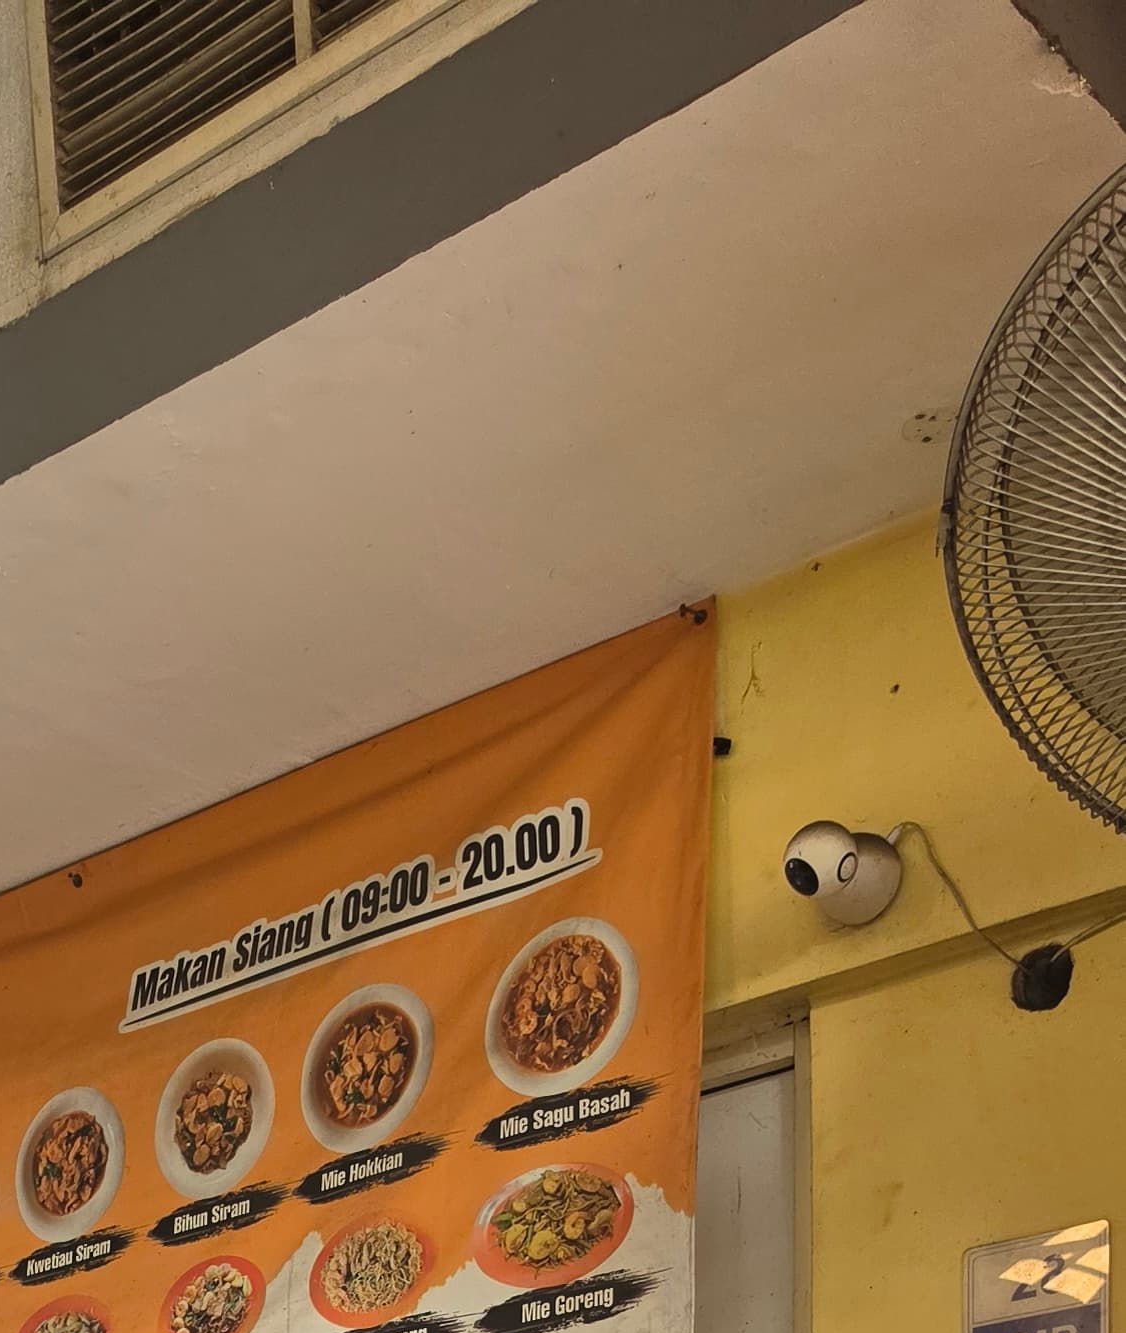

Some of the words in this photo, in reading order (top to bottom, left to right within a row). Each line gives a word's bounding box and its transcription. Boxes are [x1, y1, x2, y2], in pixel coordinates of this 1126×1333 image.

[131, 947, 226, 1012] Makan
[232, 910, 314, 972] Siang
[340, 861, 430, 932] 09:00
[462, 814, 561, 891] 20.00
[499, 1115, 529, 1140] Mie
[532, 1105, 574, 1133] Sagu
[578, 1089, 630, 1120] Basah
[320, 1169, 346, 1191] Mie
[349, 1151, 404, 1185] Hokkian
[173, 1208, 209, 1235] Bihun
[210, 1198, 250, 1225] Siram
[26, 1248, 74, 1277] Kwetiau
[75, 1239, 111, 1263] Siram
[521, 1298, 552, 1324] Mie
[556, 1285, 614, 1316] Goreng
